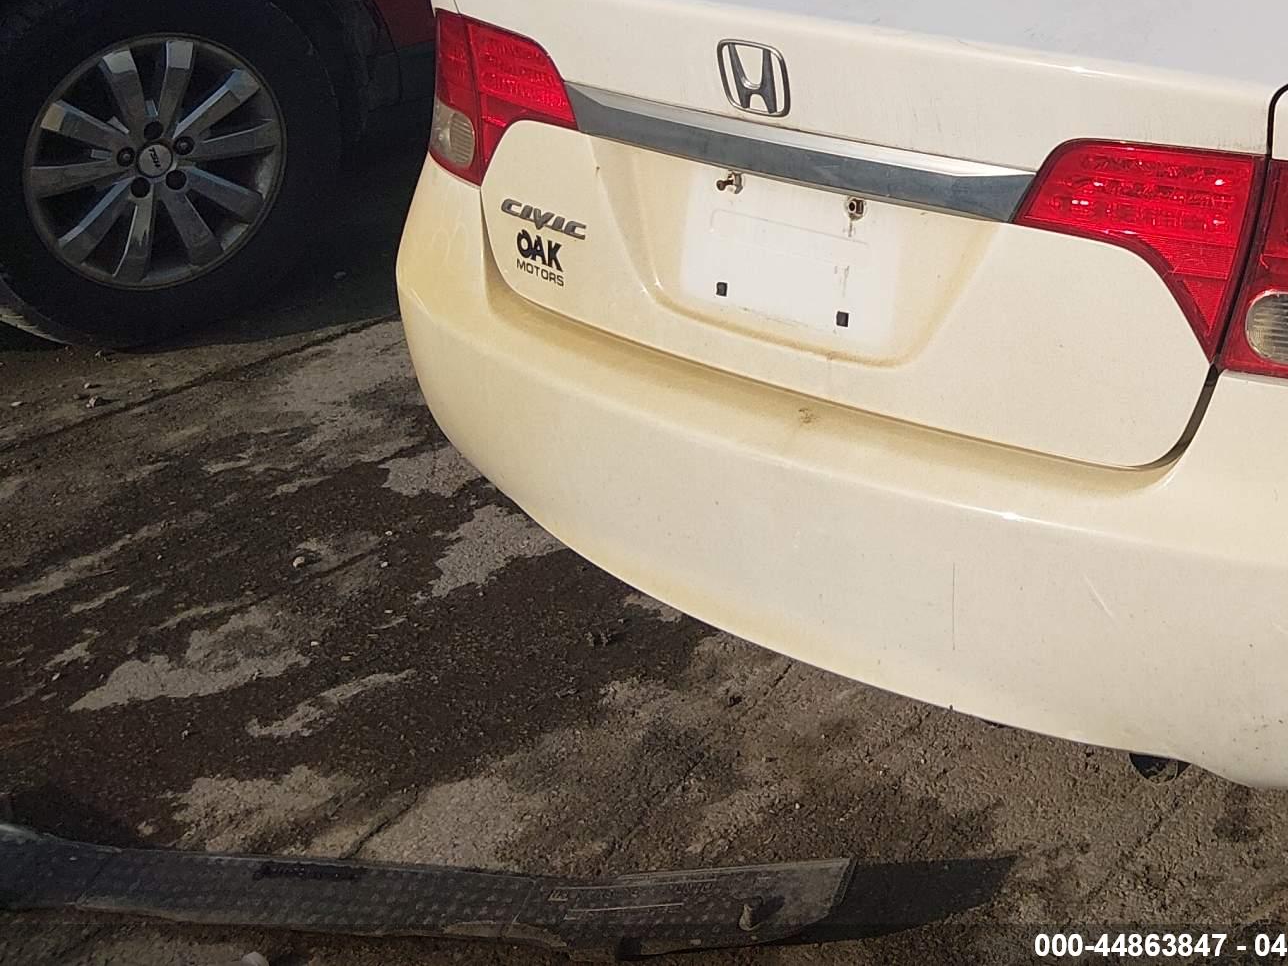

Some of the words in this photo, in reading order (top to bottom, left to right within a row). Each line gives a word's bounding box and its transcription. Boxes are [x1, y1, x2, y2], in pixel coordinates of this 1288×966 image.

[501, 198, 587, 240] CIVIC
[516, 228, 564, 272] OAK
[516, 258, 565, 287] MOTORS
